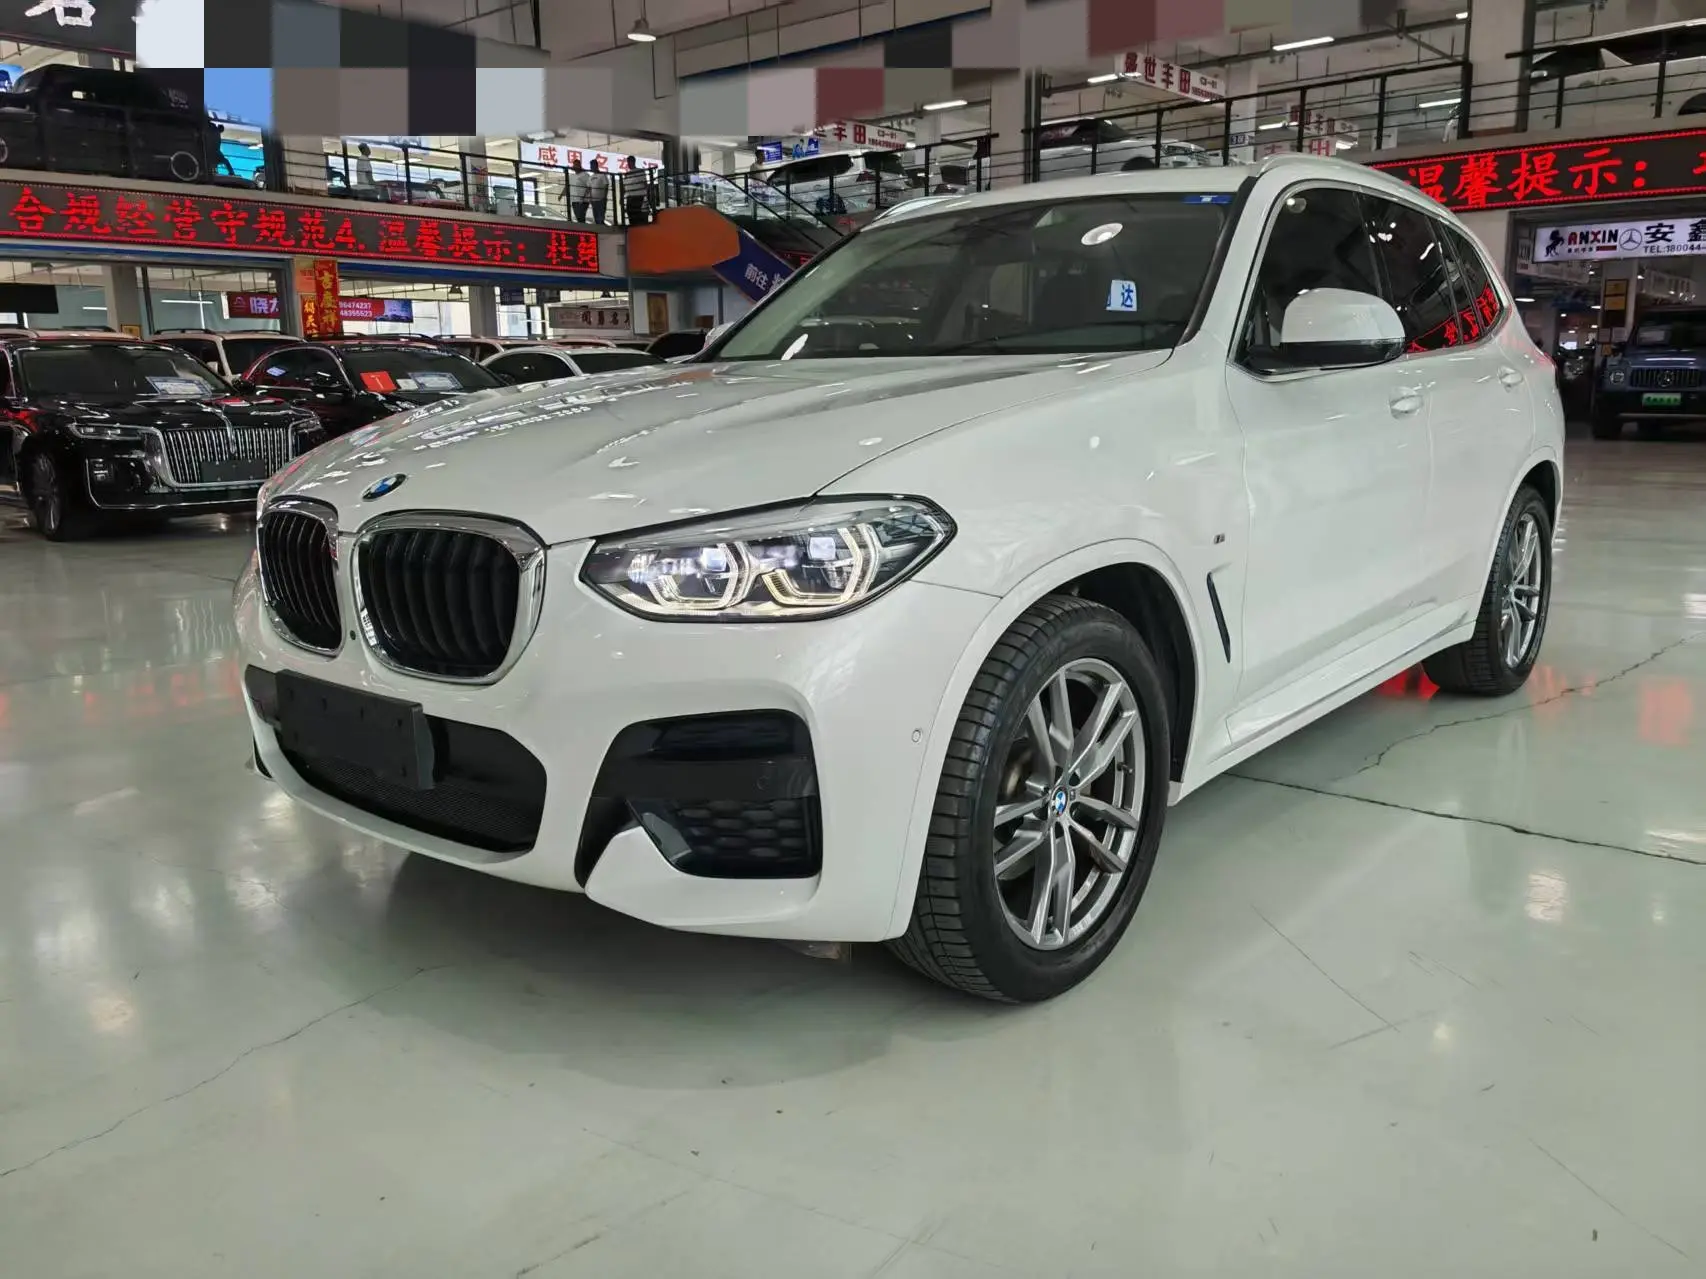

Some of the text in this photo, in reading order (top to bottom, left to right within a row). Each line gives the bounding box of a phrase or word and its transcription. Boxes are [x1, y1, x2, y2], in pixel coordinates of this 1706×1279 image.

[1404, 148, 1706, 207] 温馨提示：
[1567, 229, 1619, 246] ANXIN
